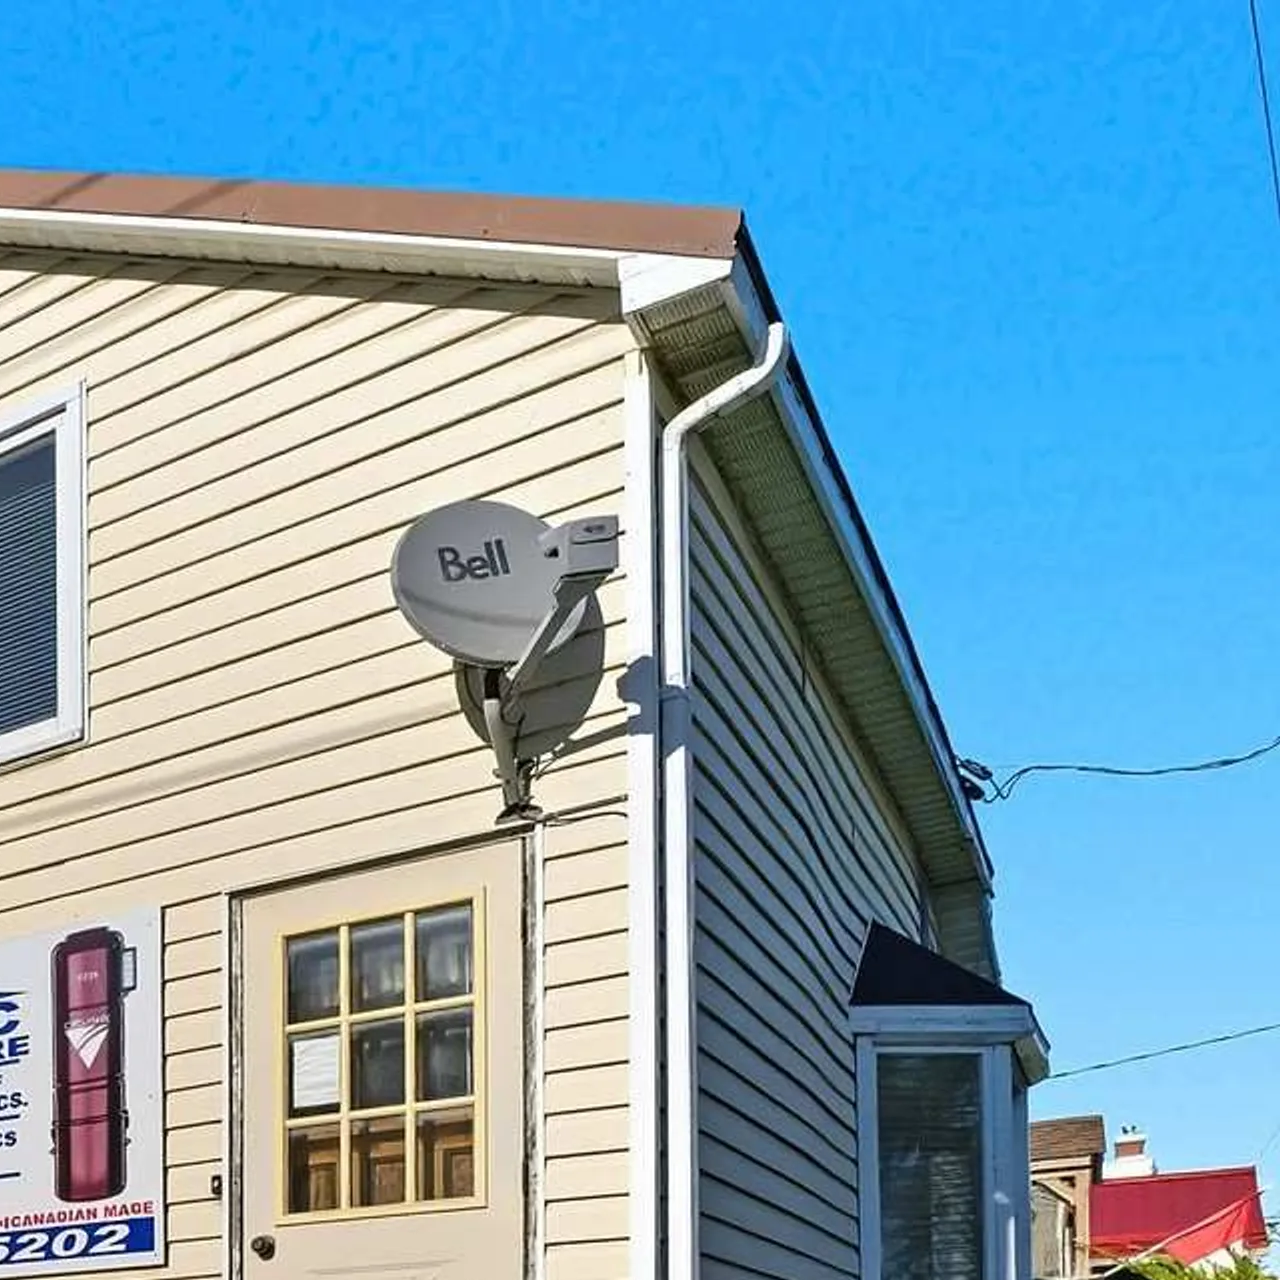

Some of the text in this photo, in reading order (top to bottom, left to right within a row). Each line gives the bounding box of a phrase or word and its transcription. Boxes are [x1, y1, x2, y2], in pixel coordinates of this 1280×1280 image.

[438, 539, 510, 582] Bell
[10, 1200, 154, 1229] CANADIAN MADE
